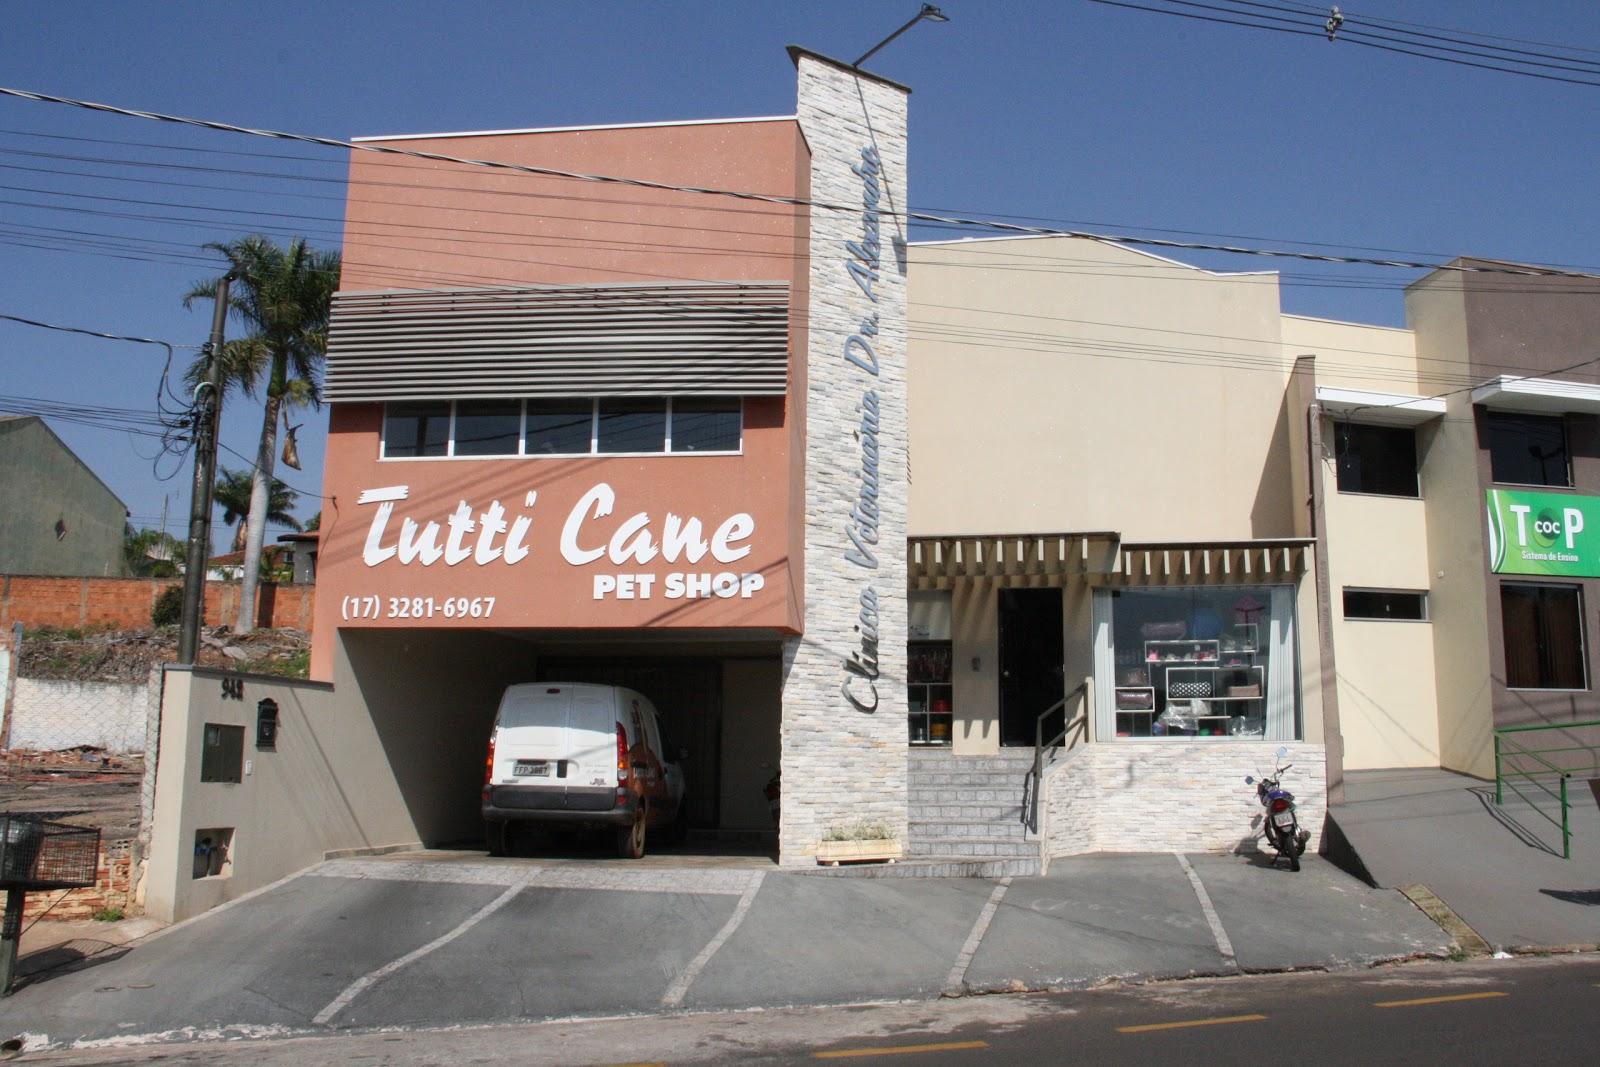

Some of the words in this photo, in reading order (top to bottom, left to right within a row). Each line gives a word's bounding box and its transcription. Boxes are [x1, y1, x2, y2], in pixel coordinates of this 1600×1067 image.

[357, 485, 538, 567] Tutti
[559, 482, 755, 566] Cane
[1521, 550, 1548, 560] Sistema
[1548, 552, 1557, 561] de
[1557, 552, 1579, 562] Ensino
[593, 574, 656, 600] PET
[665, 572, 765, 599] SHOP
[341, 595, 380, 620] (17)
[388, 596, 495, 619] 3281-6967
